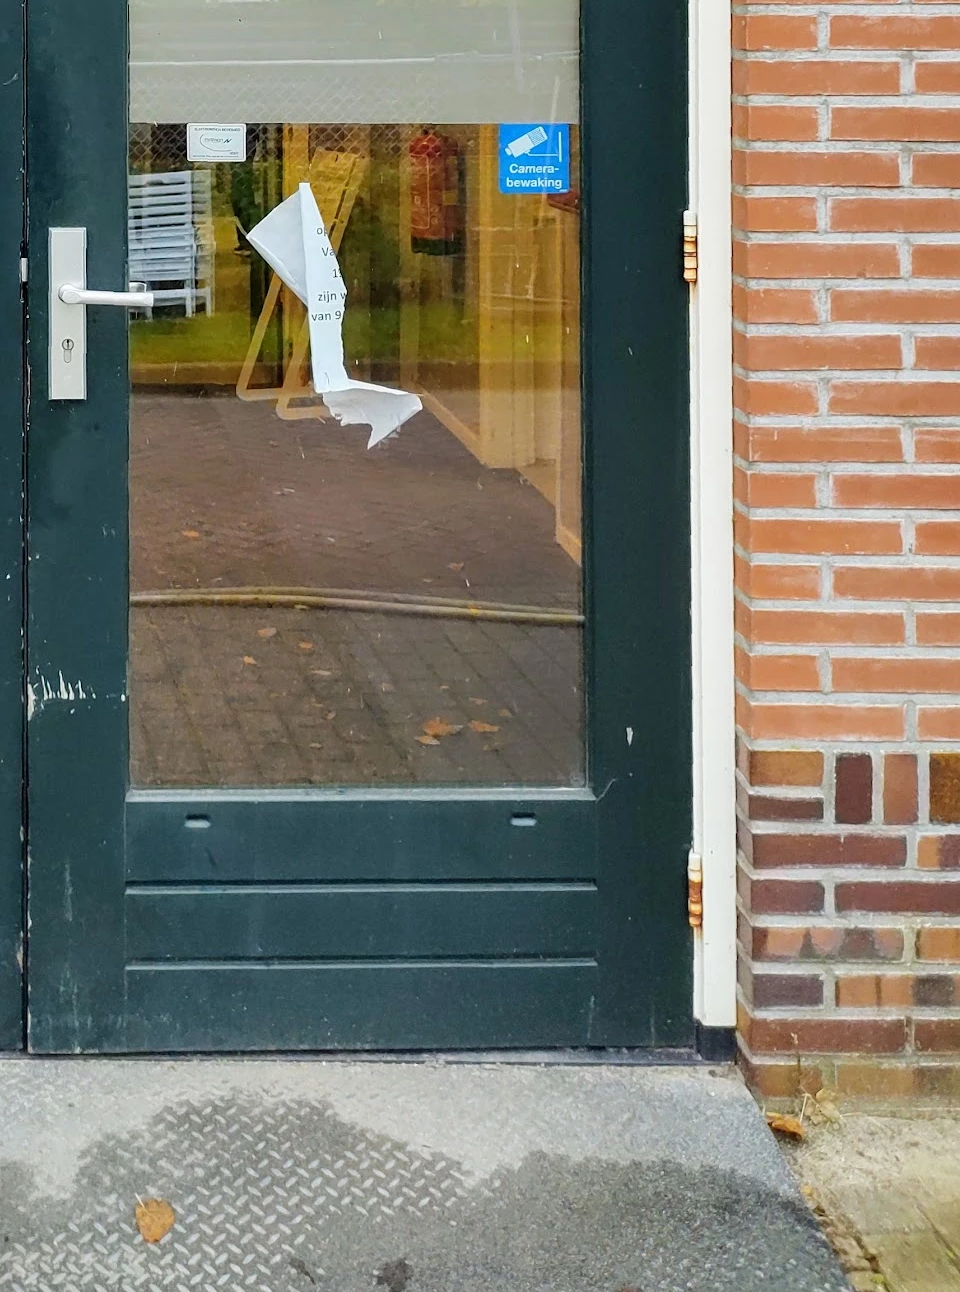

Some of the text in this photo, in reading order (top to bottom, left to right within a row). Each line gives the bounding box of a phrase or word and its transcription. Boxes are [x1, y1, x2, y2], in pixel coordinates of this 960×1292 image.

[509, 163, 560, 174] Camera-
[506, 177, 562, 189] bewaking
[317, 291, 337, 303] zijn
[311, 312, 331, 321] van
